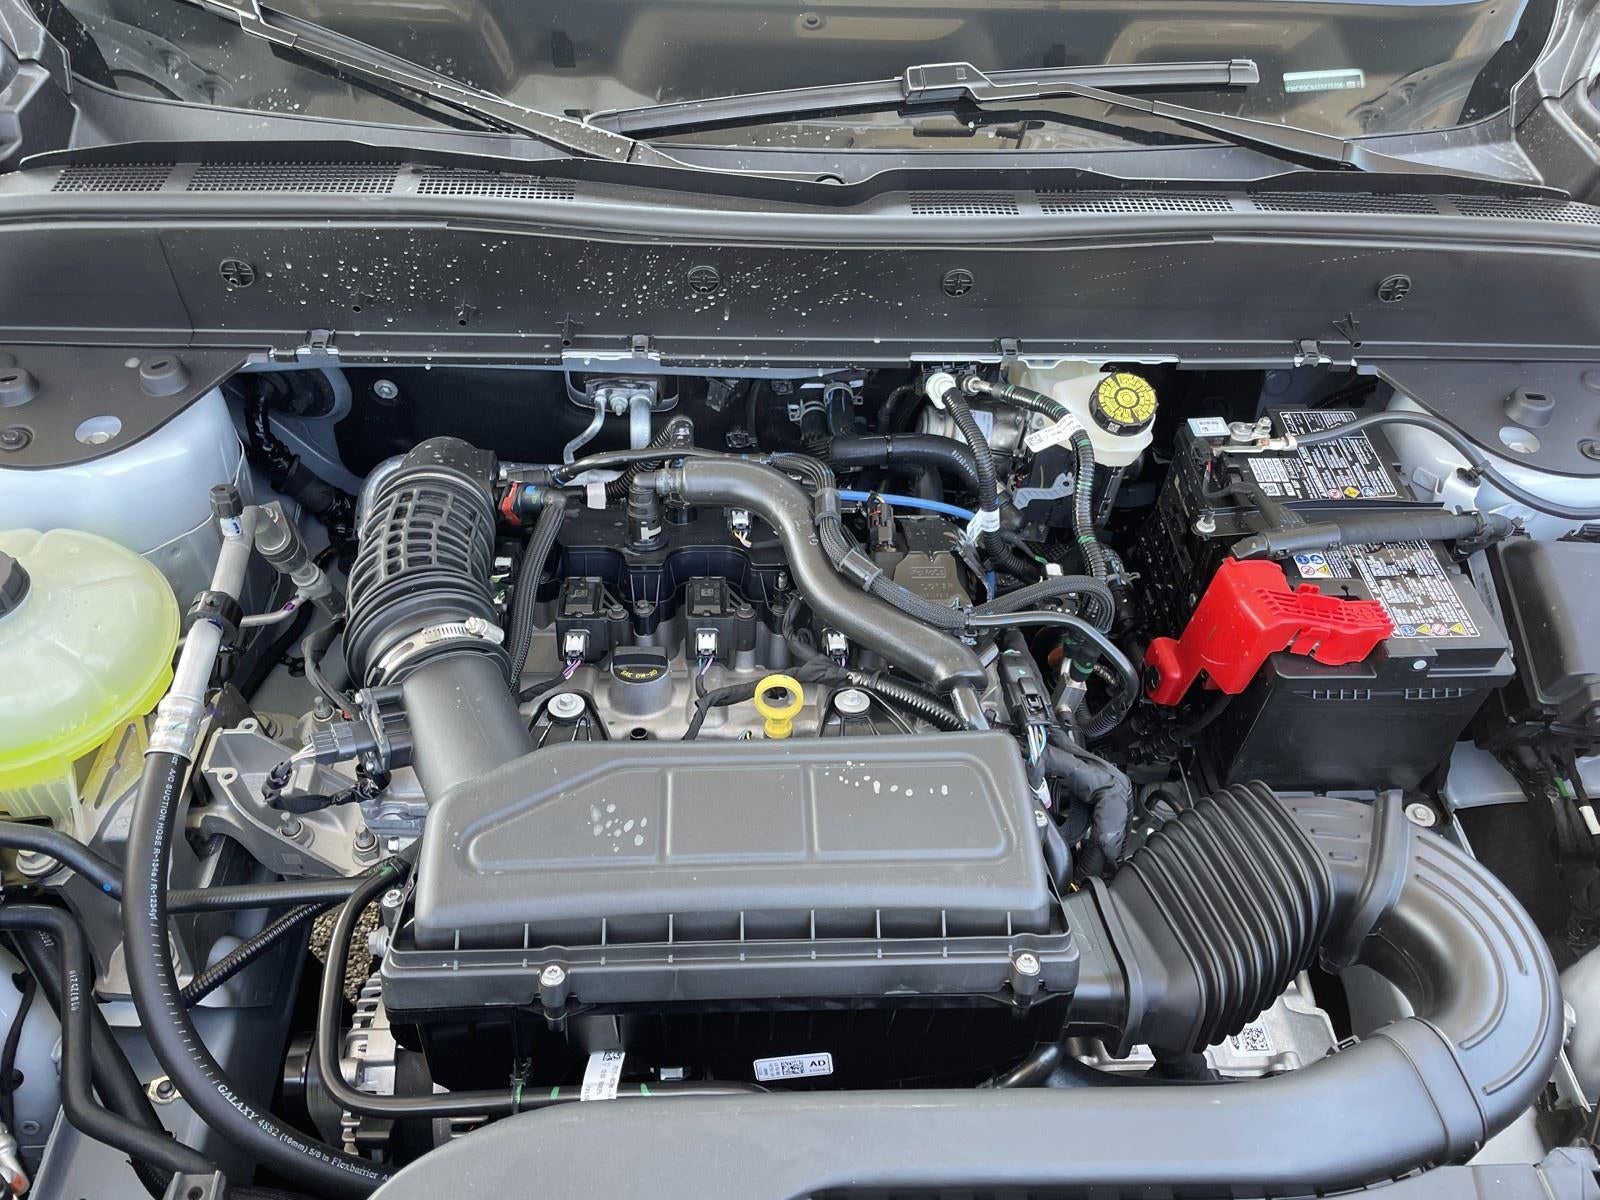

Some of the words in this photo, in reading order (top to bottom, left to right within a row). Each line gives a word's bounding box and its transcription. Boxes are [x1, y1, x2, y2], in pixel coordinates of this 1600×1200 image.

[167, 768, 176, 783] A/C
[159, 783, 173, 821] SUCTION
[154, 822, 165, 846] HOSE
[151, 847, 161, 877] R-134a
[148, 883, 158, 920] R-1234yf
[217, 1084, 259, 1120] GALAXY
[257, 1119, 280, 1137] 4882
[279, 1132, 309, 1153] (16mm)
[308, 1148, 322, 1159] 5/8
[321, 1153, 330, 1162] in
[331, 1156, 379, 1180] Flexbarrier
